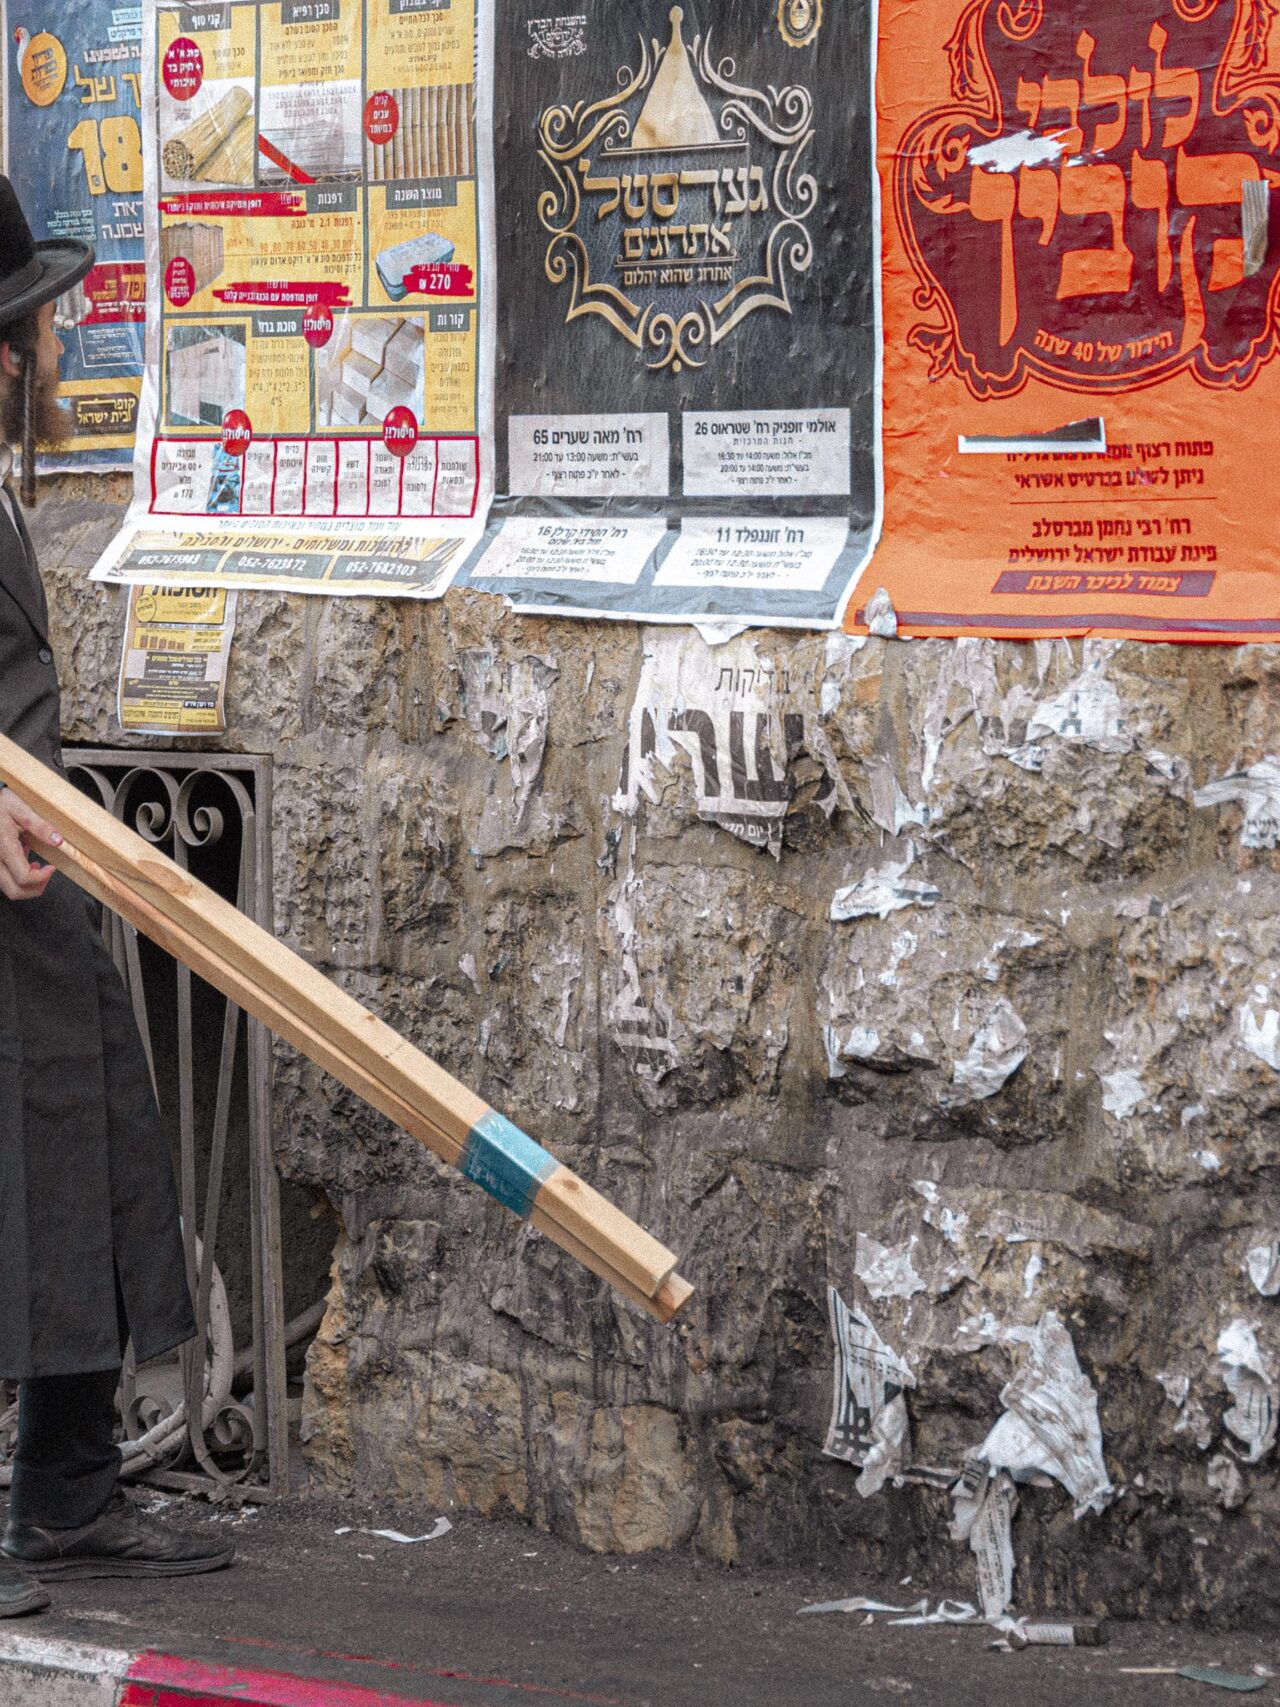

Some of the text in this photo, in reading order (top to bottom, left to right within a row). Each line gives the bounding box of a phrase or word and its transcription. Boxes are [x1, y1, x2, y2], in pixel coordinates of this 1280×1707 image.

[314, 3, 330, 19] סכך
[191, 15, 206, 30] סוף
[73, 63, 118, 104] של
[1015, 20, 1201, 154] לולבי
[373, 109, 389, 120] עבים
[369, 123, 392, 135] במיוחד
[317, 192, 343, 206] דפנות
[394, 187, 442, 202] מוצר השנה
[623, 222, 733, 259] אתרוגים
[429, 273, 451, 290] 270
[623, 265, 733, 286] אתרוג שהוא יהלום
[276, 319, 297, 333] סוכת
[303, 316, 332, 332] חיסול!!
[1033, 328, 1174, 363] הידור של 40 שנה
[222, 426, 251, 440] חיסול!!
[384, 425, 415, 440] חיסול!!
[694, 418, 836, 437] אולמי זופניק רח' שטראוס 26
[533, 426, 643, 446] רח' מאה שערים 65
[732, 436, 794, 446] חנות המרכזית
[1136, 442, 1172, 463] רצוף
[1174, 440, 1214, 457] פתוח
[346, 459, 360, 469] דשא
[533, 452, 553, 462] 21:00
[554, 453, 563, 462] עד
[566, 452, 586, 462] 13:00
[601, 468, 620, 480] לאחר
[1014, 471, 1064, 489] אשראי
[1067, 470, 1122, 487] בכרטיס
[1173, 468, 1204, 488] ניתן
[181, 489, 194, 499] 170
[537, 525, 552, 537] 16
[580, 527, 608, 538] חסידי
[716, 526, 805, 543] רח' זוננפלד 11
[1031, 516, 1191, 541] רח' רבי נחמן מברסלב
[232, 536, 354, 552] ומשלוחים ירושלים
[1008, 543, 1218, 563] פינת עבודת ישראל ירושלים
[1024, 572, 1182, 593] צמוד לכיכר השבת
